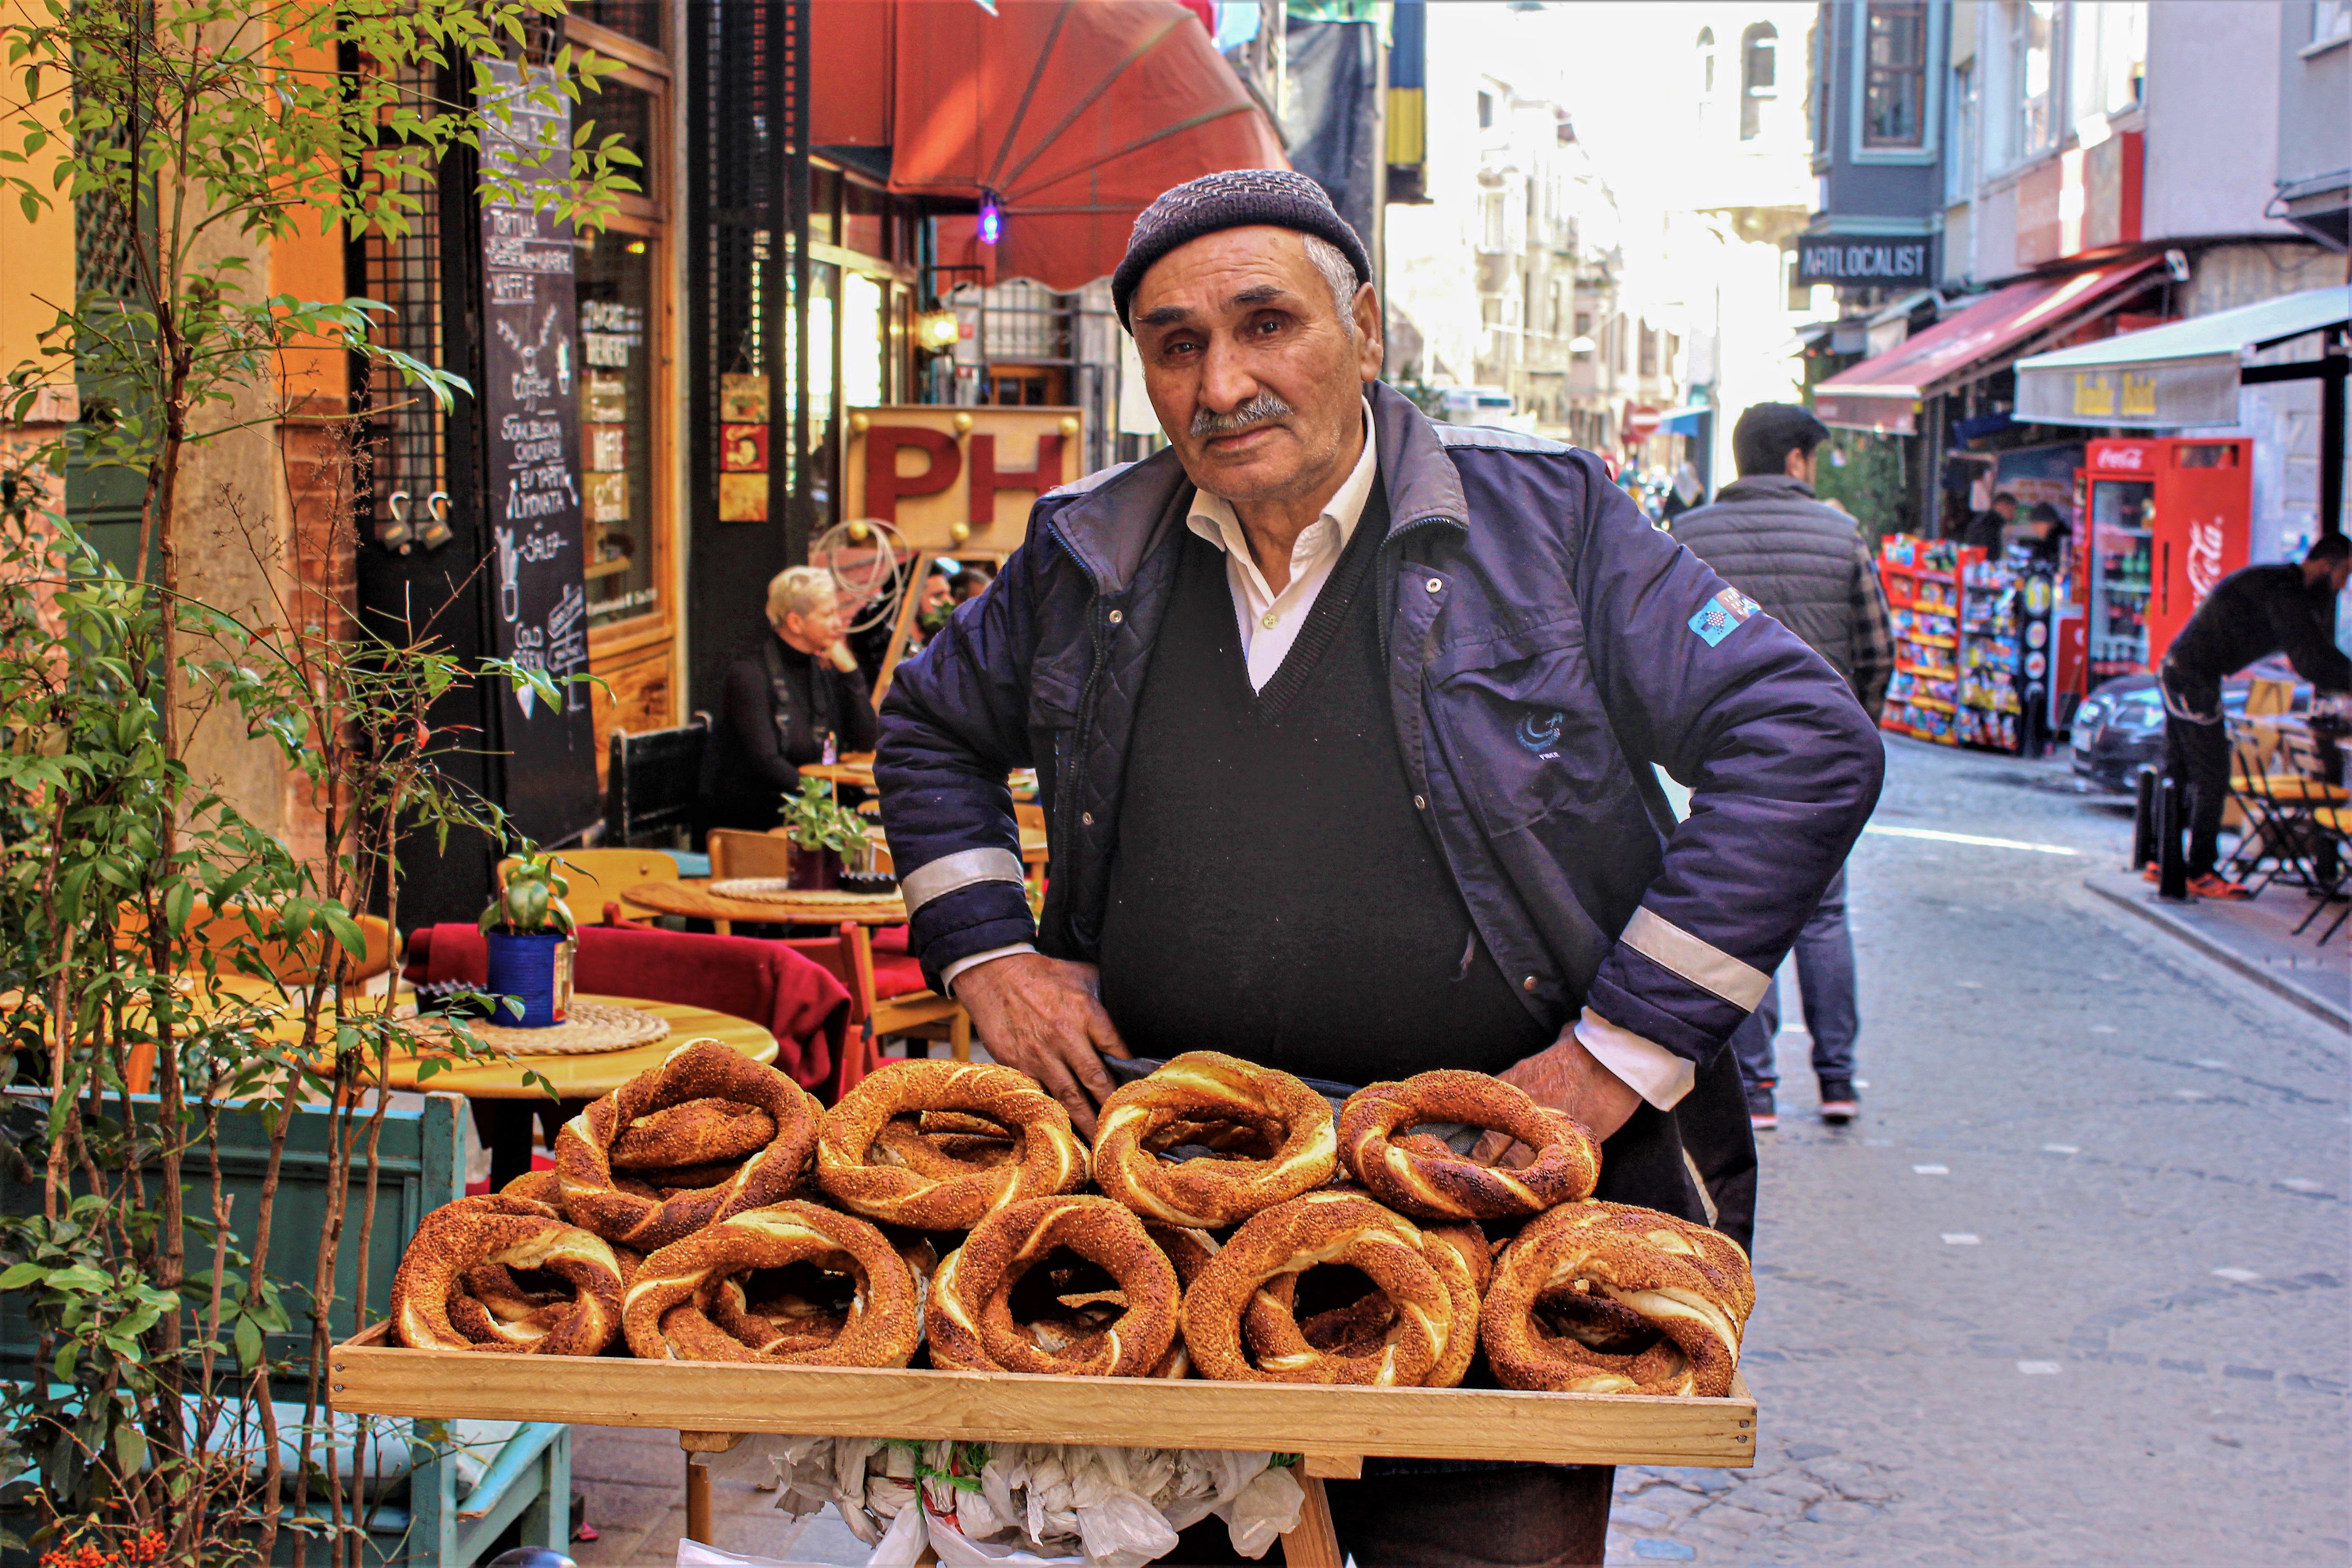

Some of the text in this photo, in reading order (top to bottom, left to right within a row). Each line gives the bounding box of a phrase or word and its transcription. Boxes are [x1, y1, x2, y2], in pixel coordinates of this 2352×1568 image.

[1801, 245, 1924, 276] ARTLOCALIST
[491, 273, 534, 299] WAFFLE
[866, 426, 1062, 525] PH
